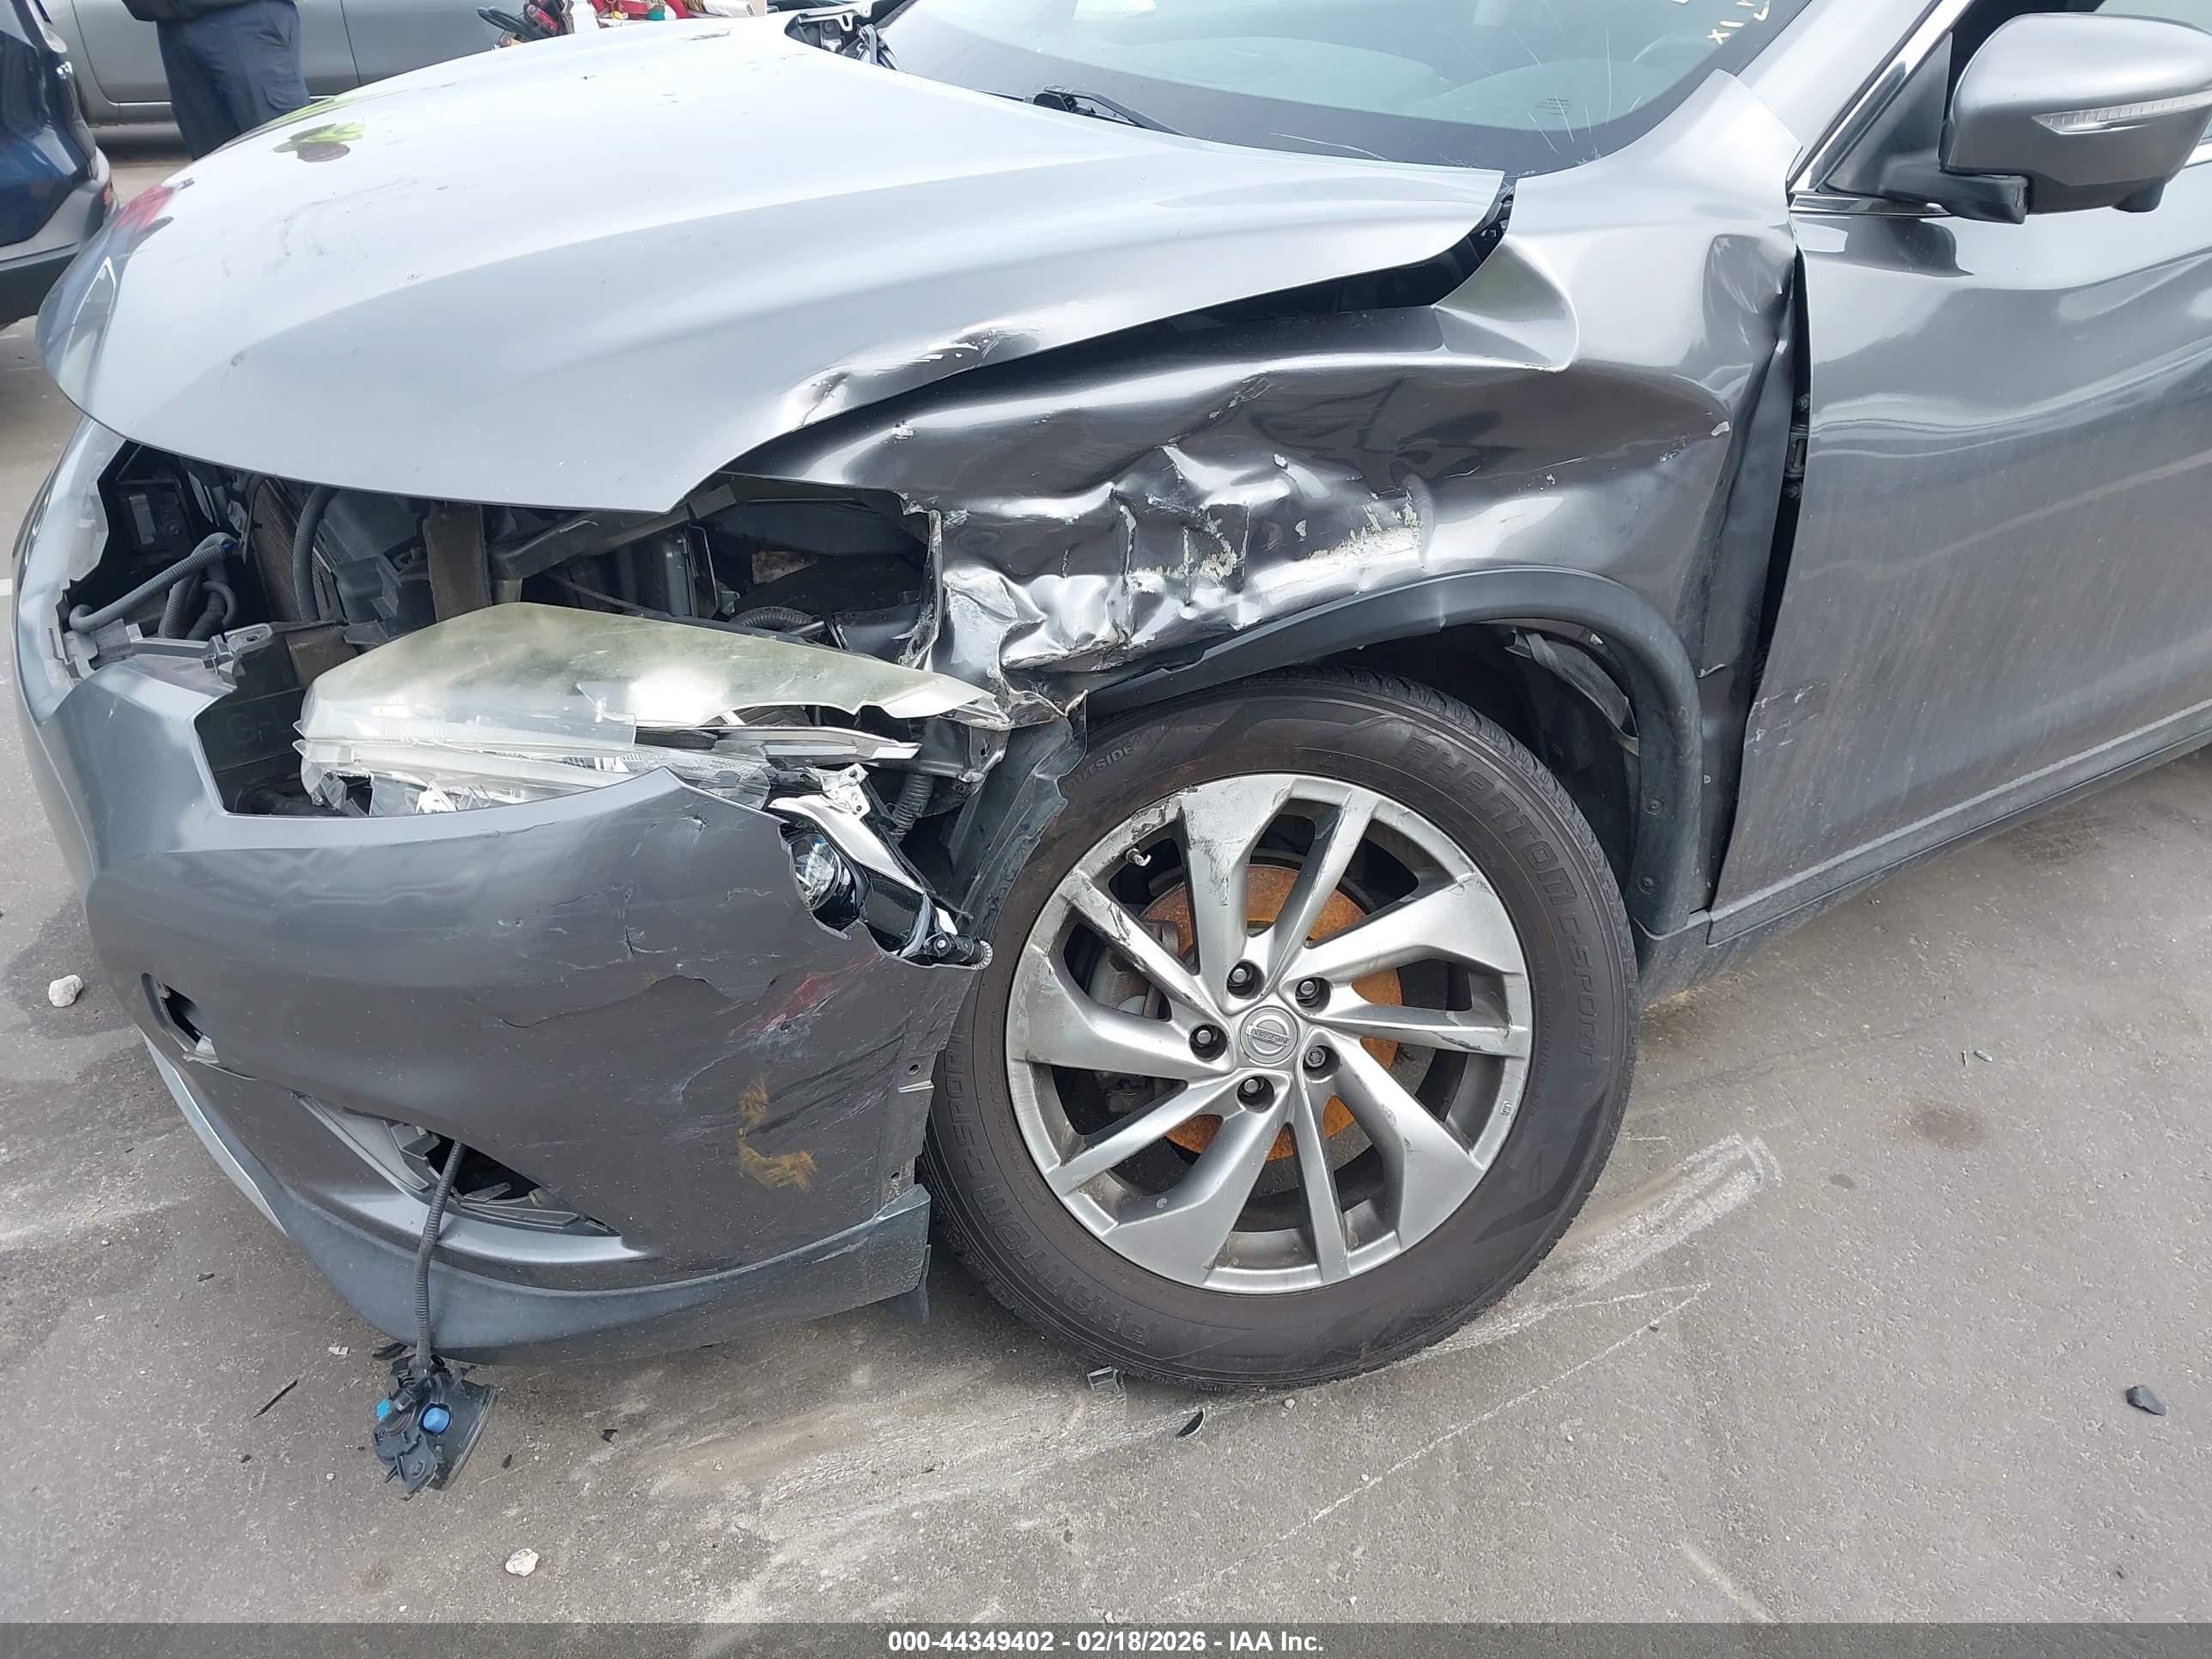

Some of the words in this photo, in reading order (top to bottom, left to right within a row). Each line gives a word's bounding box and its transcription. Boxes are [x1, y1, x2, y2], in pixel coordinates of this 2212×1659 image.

[1395, 736, 1578, 907] PHANTOM
[1558, 912, 1599, 1066] C-SPORT
[1250, 1028, 1288, 1044] NISSAN
